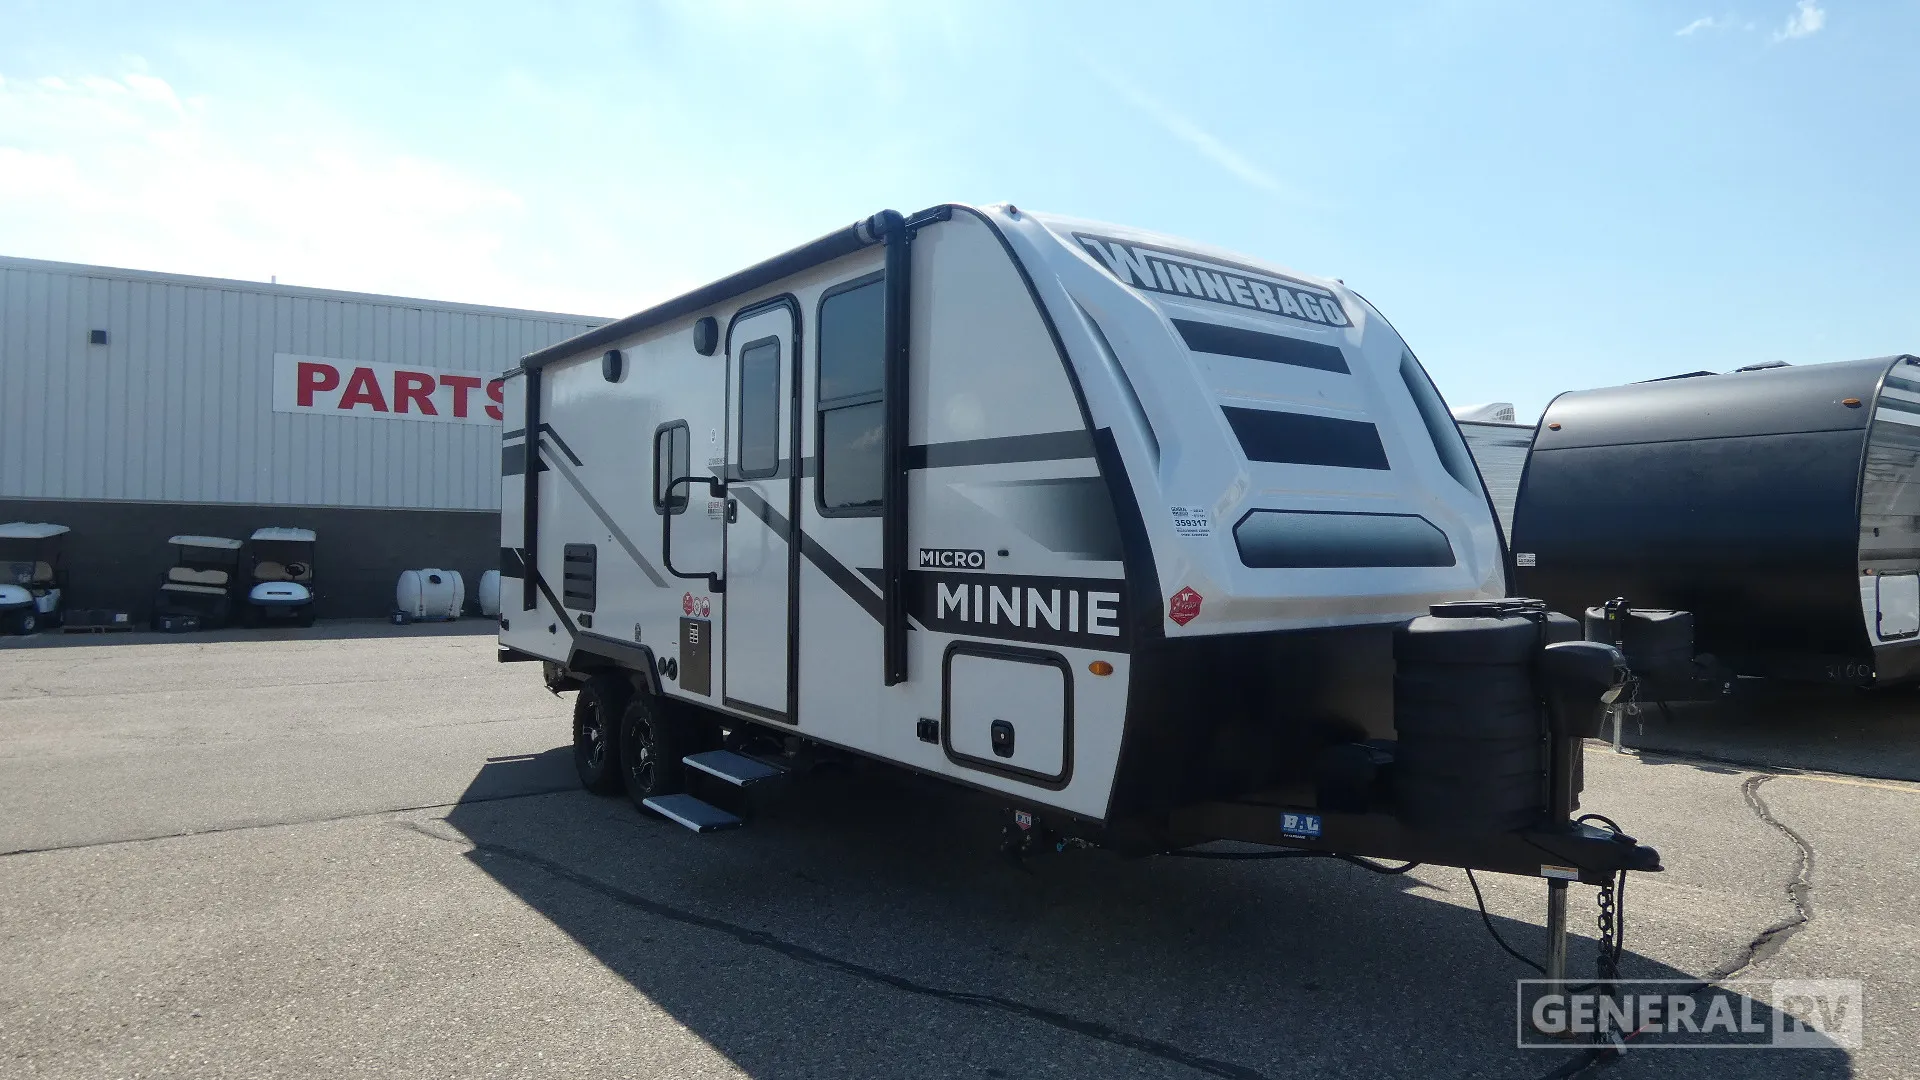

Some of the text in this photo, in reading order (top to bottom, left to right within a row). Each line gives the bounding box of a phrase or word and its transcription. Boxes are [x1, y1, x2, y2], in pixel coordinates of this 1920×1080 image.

[1080, 237, 1348, 326] WINNEBAGO
[1174, 519, 1208, 527] 359317
[920, 550, 983, 567] MICRO
[937, 582, 1120, 637] MINNIE
